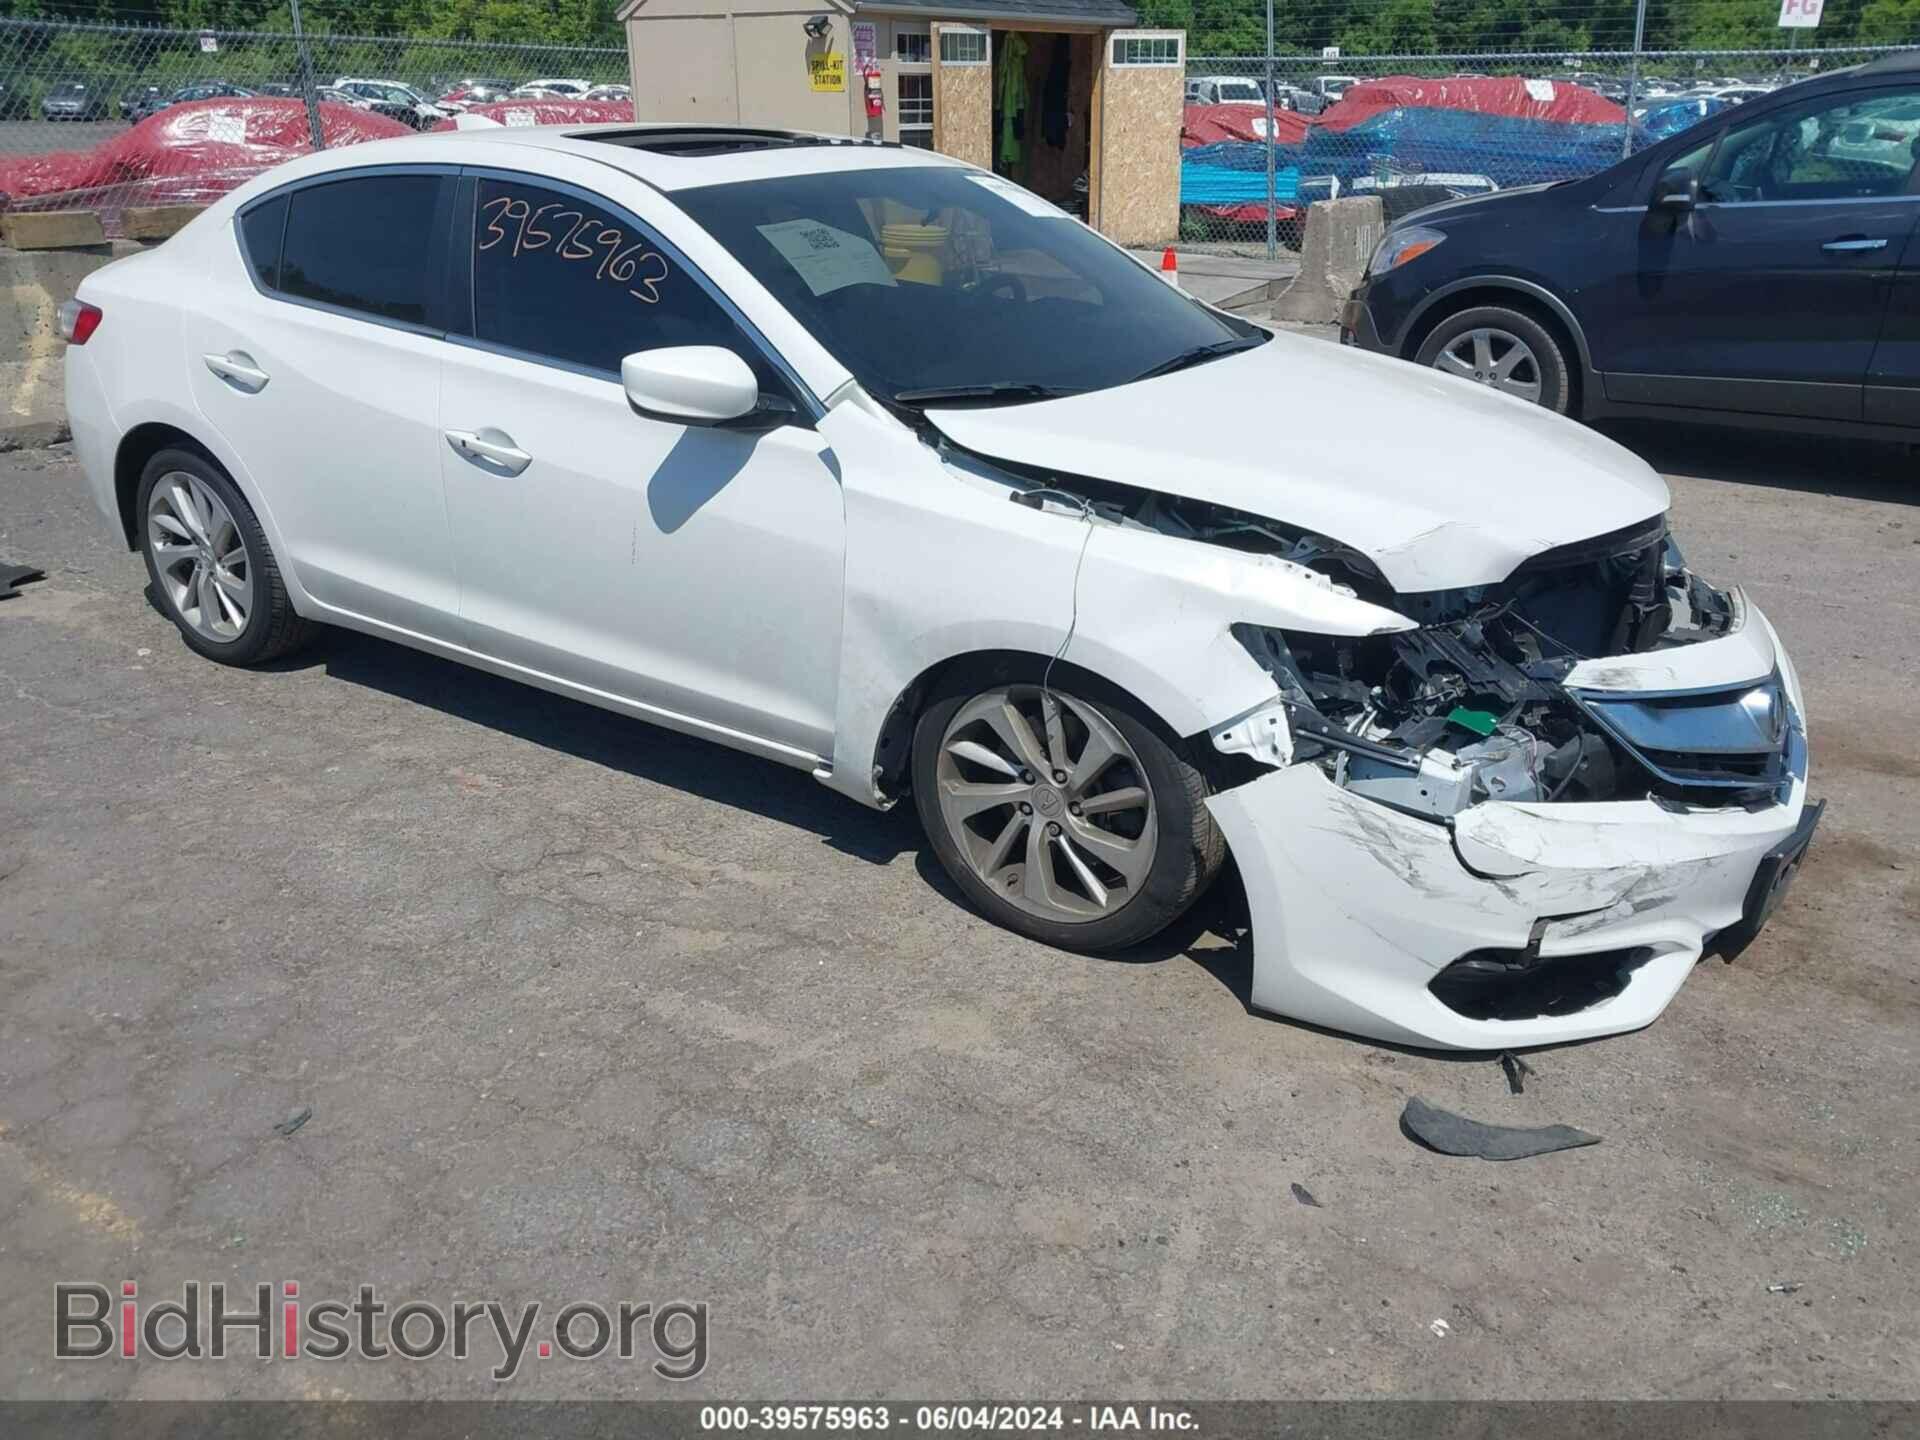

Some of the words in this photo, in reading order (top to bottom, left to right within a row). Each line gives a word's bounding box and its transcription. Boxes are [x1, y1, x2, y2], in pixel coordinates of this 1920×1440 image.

[1785, 0, 1818, 16] FG
[814, 74, 842, 85] STATION
[479, 197, 669, 304] 39575963
